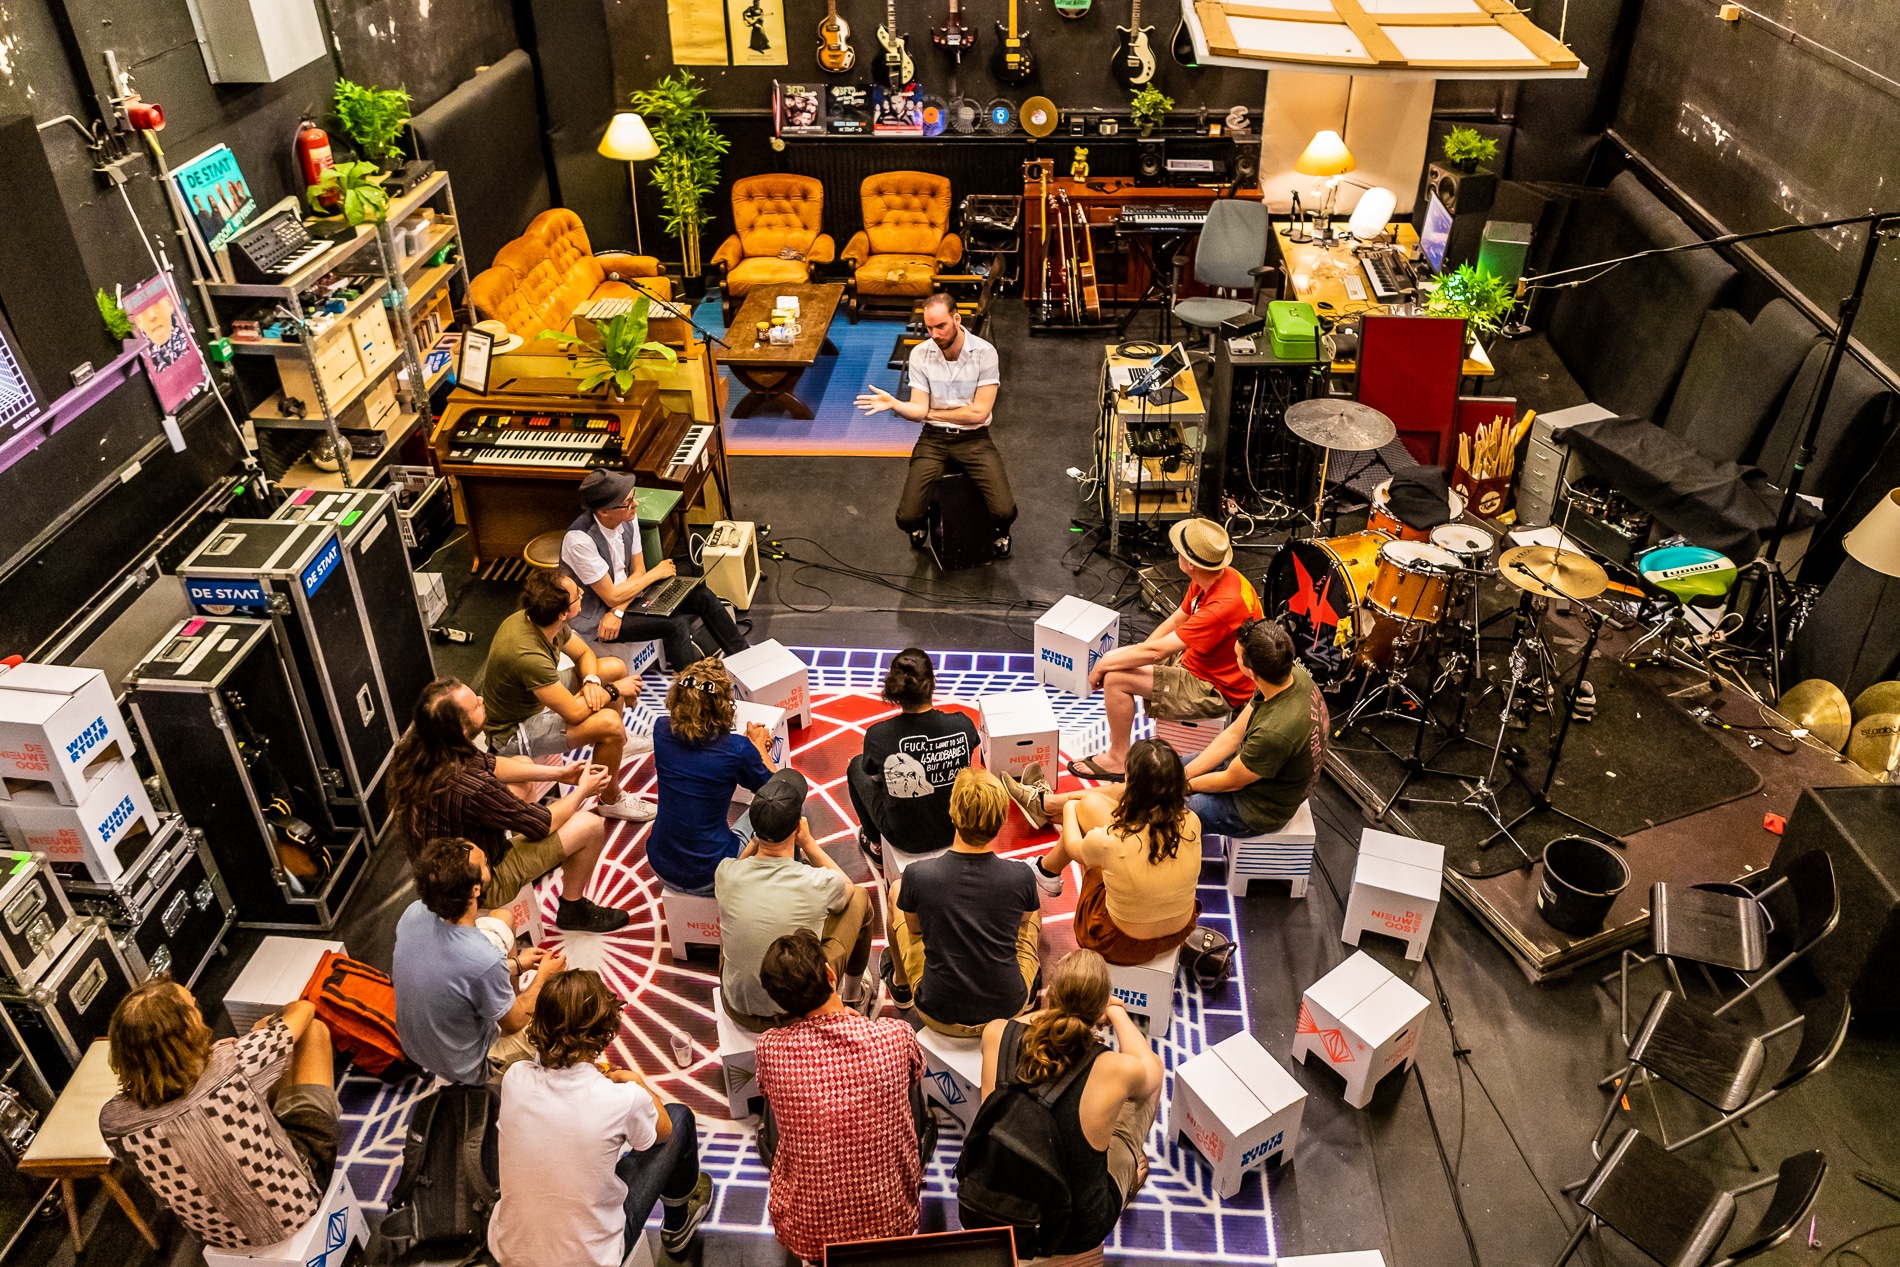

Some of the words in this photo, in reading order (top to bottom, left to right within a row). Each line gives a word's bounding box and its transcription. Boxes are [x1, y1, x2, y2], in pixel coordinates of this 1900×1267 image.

[186, 171, 203, 188] DE
[201, 158, 231, 182] STAAT
[306, 570, 319, 589] DE
[316, 546, 337, 576] STAAT
[1662, 563, 1720, 578] Ludwig
[191, 588, 213, 598] DE
[215, 588, 259, 599] STAAT
[633, 641, 654, 664] WINTE
[634, 646, 656, 671] RTUIN
[1041, 647, 1073, 664] WINTE
[1041, 653, 1073, 672] RTUIN
[791, 686, 803, 696] DE
[786, 700, 803, 711] OST
[65, 715, 105, 754] WINTE
[24, 743, 44, 753] DE
[70, 724, 109, 763] RTUIN
[904, 741, 928, 752] FUCK,
[929, 743, 933, 751] I
[949, 739, 956, 747] TO
[956, 736, 965, 745] SEE
[0, 751, 48, 762] NIEUWE
[1009, 753, 1050, 764] NIEUWE
[15, 761, 50, 771] OOST
[926, 762, 940, 772] BUT
[942, 760, 953, 769] I'M
[954, 757, 960, 765] A
[931, 772, 946, 784] U.S.
[98, 795, 132, 834] WINTE
[102, 803, 135, 843] RTUIN
[58, 828, 78, 837] DE
[28, 836, 81, 846] NIEUWE
[48, 846, 83, 854] OOST
[1371, 910, 1421, 927] NIEUWE
[1405, 911, 1423, 920] DE
[687, 922, 720, 931] NIEU
[1384, 921, 1420, 934] OOST
[702, 930, 720, 938] OO
[1113, 987, 1147, 1001] INTE
[1118, 994, 1147, 1008] UIN
[1211, 1131, 1225, 1147] DE
[1242, 1130, 1284, 1158] WINTE
